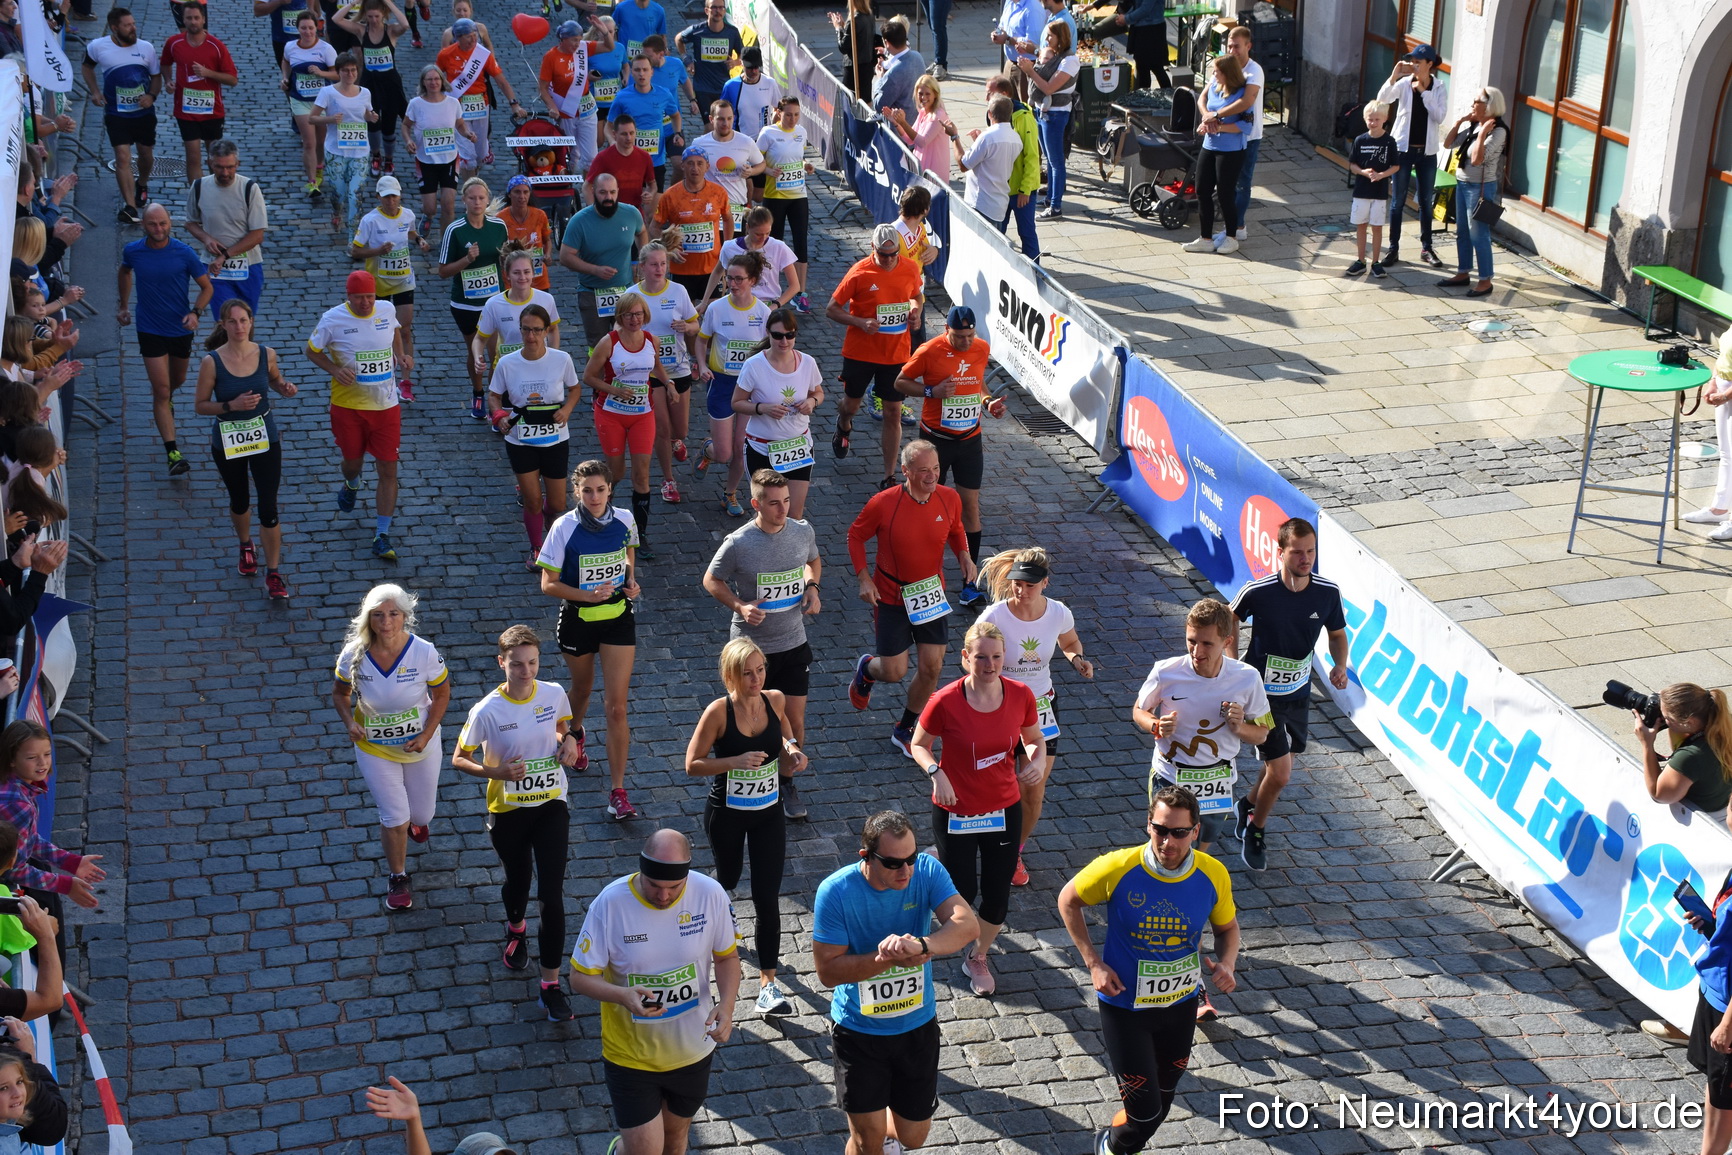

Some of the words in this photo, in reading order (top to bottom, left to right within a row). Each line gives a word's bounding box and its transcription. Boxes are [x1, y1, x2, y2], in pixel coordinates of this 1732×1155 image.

[705, 47, 726, 55] 1080
[368, 56, 389, 64] 2761
[576, 50, 585, 70] auch
[456, 75, 470, 91] wir
[466, 60, 482, 80] auch
[576, 70, 585, 87] wir
[300, 80, 321, 89] 2666
[598, 86, 618, 96] 1032
[120, 96, 140, 104] 266
[186, 98, 211, 106] 2574
[464, 102, 484, 112] 2613
[341, 131, 364, 140] 2276
[424, 128, 453, 136] BOCK
[428, 136, 451, 146] 2277
[780, 170, 802, 181] 2258
[684, 232, 710, 243] 2273
[221, 260, 244, 270] 447
[383, 259, 408, 270] 1125
[464, 266, 497, 278] BOCK
[468, 279, 496, 292] 2030
[880, 304, 909, 313] BOCK
[880, 314, 906, 326] 2830
[358, 350, 392, 360] BOCK
[730, 351, 746, 362] 20
[996, 319, 1028, 357] stadtwerke
[1028, 351, 1056, 386] neumarkt
[360, 360, 390, 374] 2813
[946, 395, 978, 406] BOCK
[612, 403, 639, 412] CLAUDIA
[946, 407, 976, 420] 2501
[224, 420, 262, 432] BOCK
[522, 424, 555, 438] 2759
[228, 430, 262, 445] 1049
[234, 444, 260, 454] SABINE
[771, 438, 803, 450] BOCK
[1128, 402, 1184, 486] Hervis
[774, 448, 806, 465] 2429
[1192, 456, 1218, 481] STORE
[1200, 482, 1224, 512] ONLINE
[1200, 510, 1222, 541] MOBILE
[1246, 500, 1283, 574] Her
[584, 553, 622, 565] BOCK
[586, 564, 622, 581] 2599
[762, 570, 800, 583] BOCK
[763, 582, 800, 599] 2718
[906, 578, 939, 595] BOCK
[910, 590, 942, 611] 2339
[917, 605, 943, 620] THOMAS
[372, 723, 416, 738] 2634
[734, 766, 776, 778] BOCK
[1180, 768, 1227, 780] BOCK
[514, 773, 555, 792] 1045
[733, 778, 774, 796] 2743
[1182, 781, 1226, 798] 294
[517, 793, 550, 802] NADINE
[1200, 800, 1220, 809] NIEL
[961, 819, 992, 828] REGINA
[678, 913, 691, 924] 20
[680, 926, 704, 937] Stadtlauf
[1144, 956, 1194, 974] BOCK
[636, 968, 692, 986] BOCK
[868, 976, 918, 1001] 1073
[1146, 973, 1193, 994] 1074
[1141, 988, 1191, 1003] CHRISTIAN
[873, 998, 915, 1014] DOMINIC
